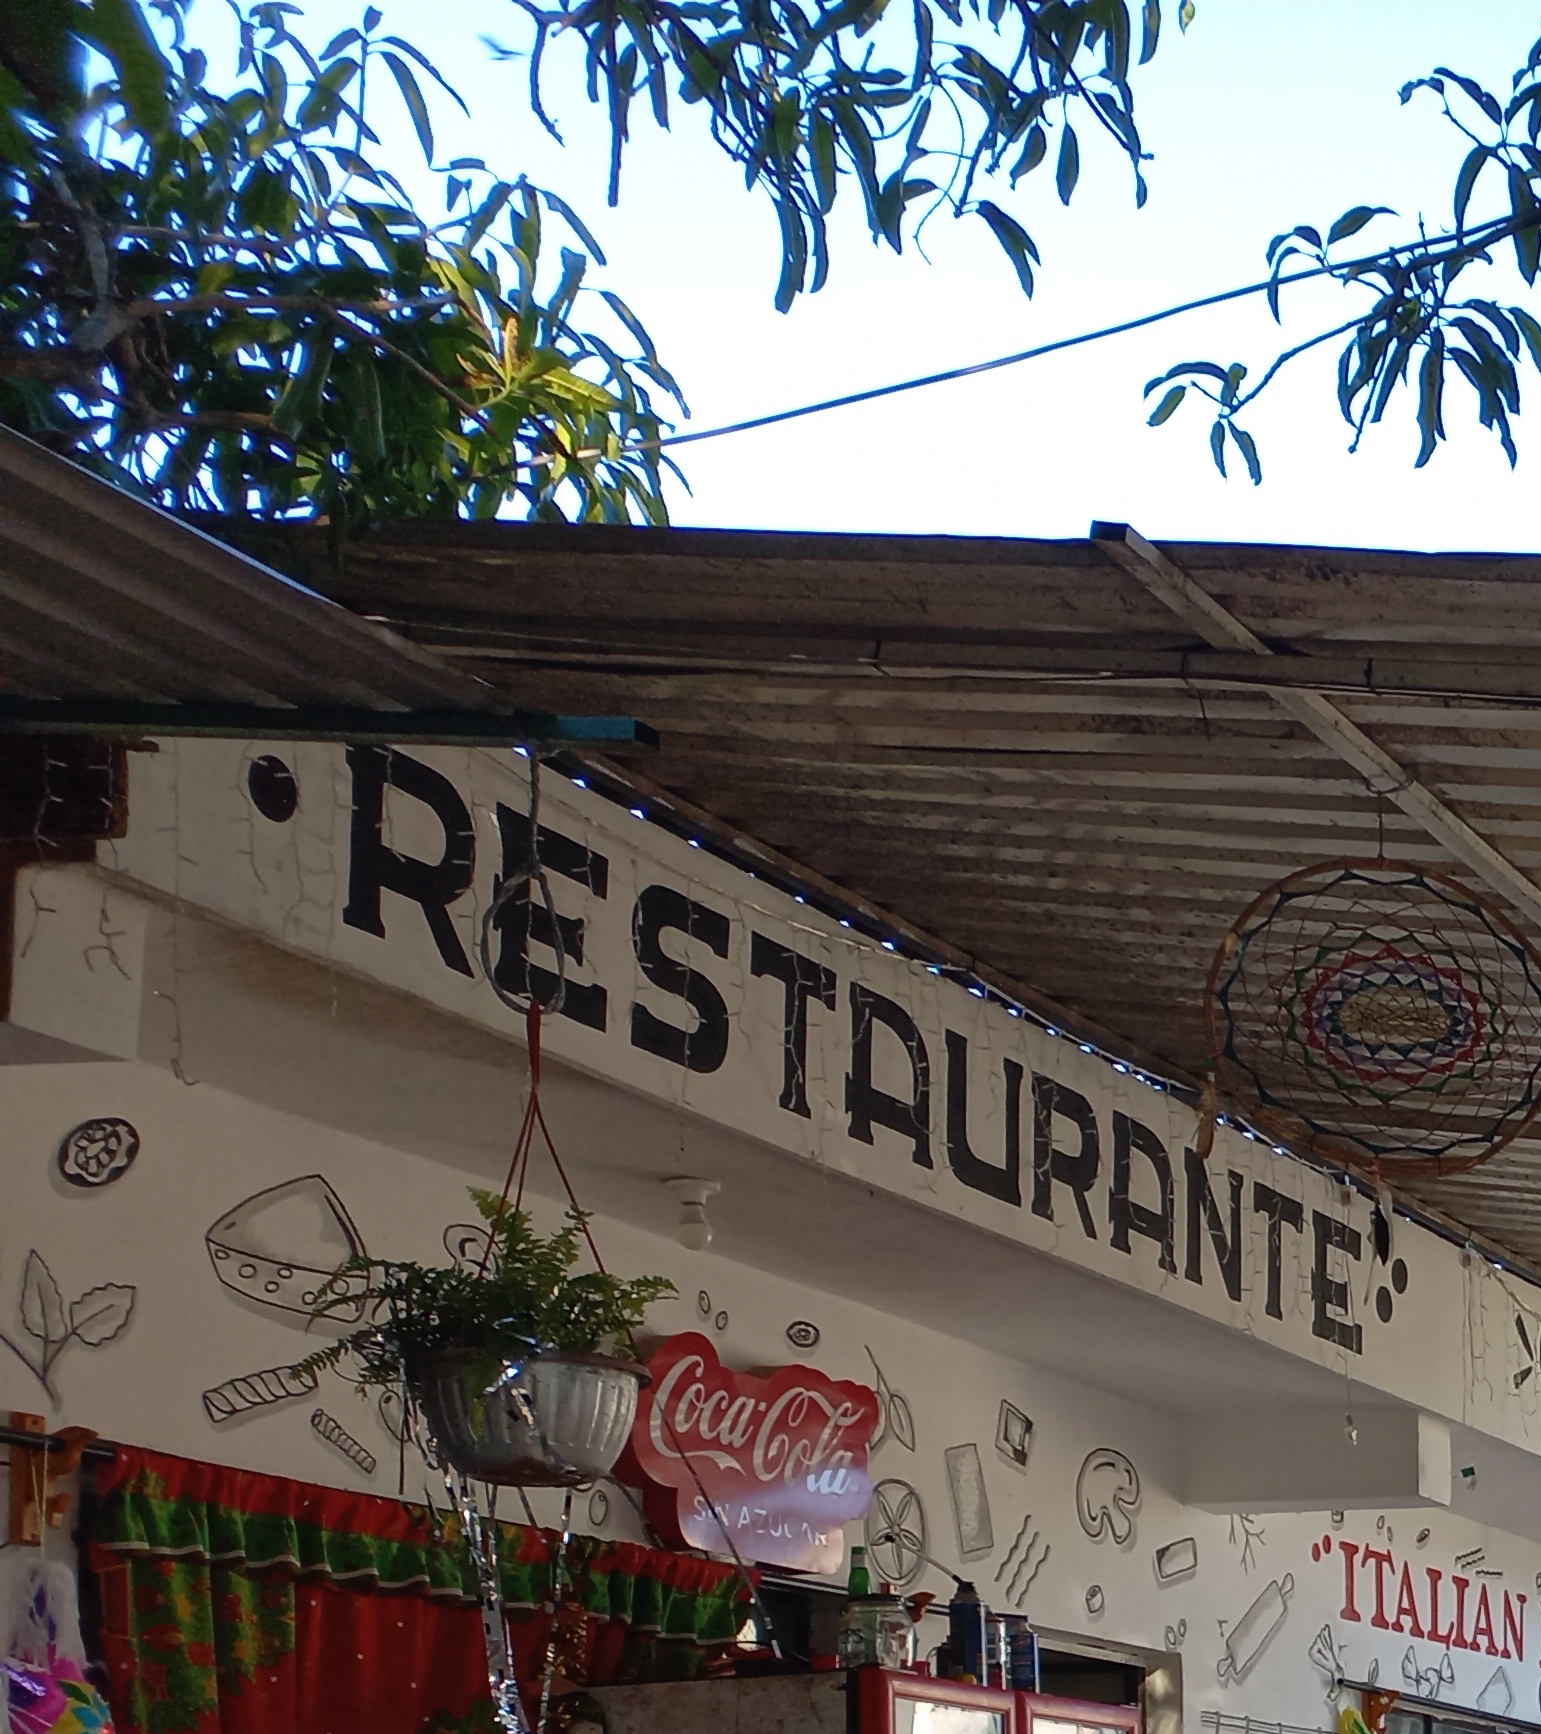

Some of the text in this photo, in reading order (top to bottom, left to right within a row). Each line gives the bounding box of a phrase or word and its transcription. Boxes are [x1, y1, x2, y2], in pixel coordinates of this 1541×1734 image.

[343, 743, 1363, 1355] RESTAURANTE
[651, 1355, 866, 1495] Coca-Cola
[1337, 1541, 1527, 1662] ITALIAN
